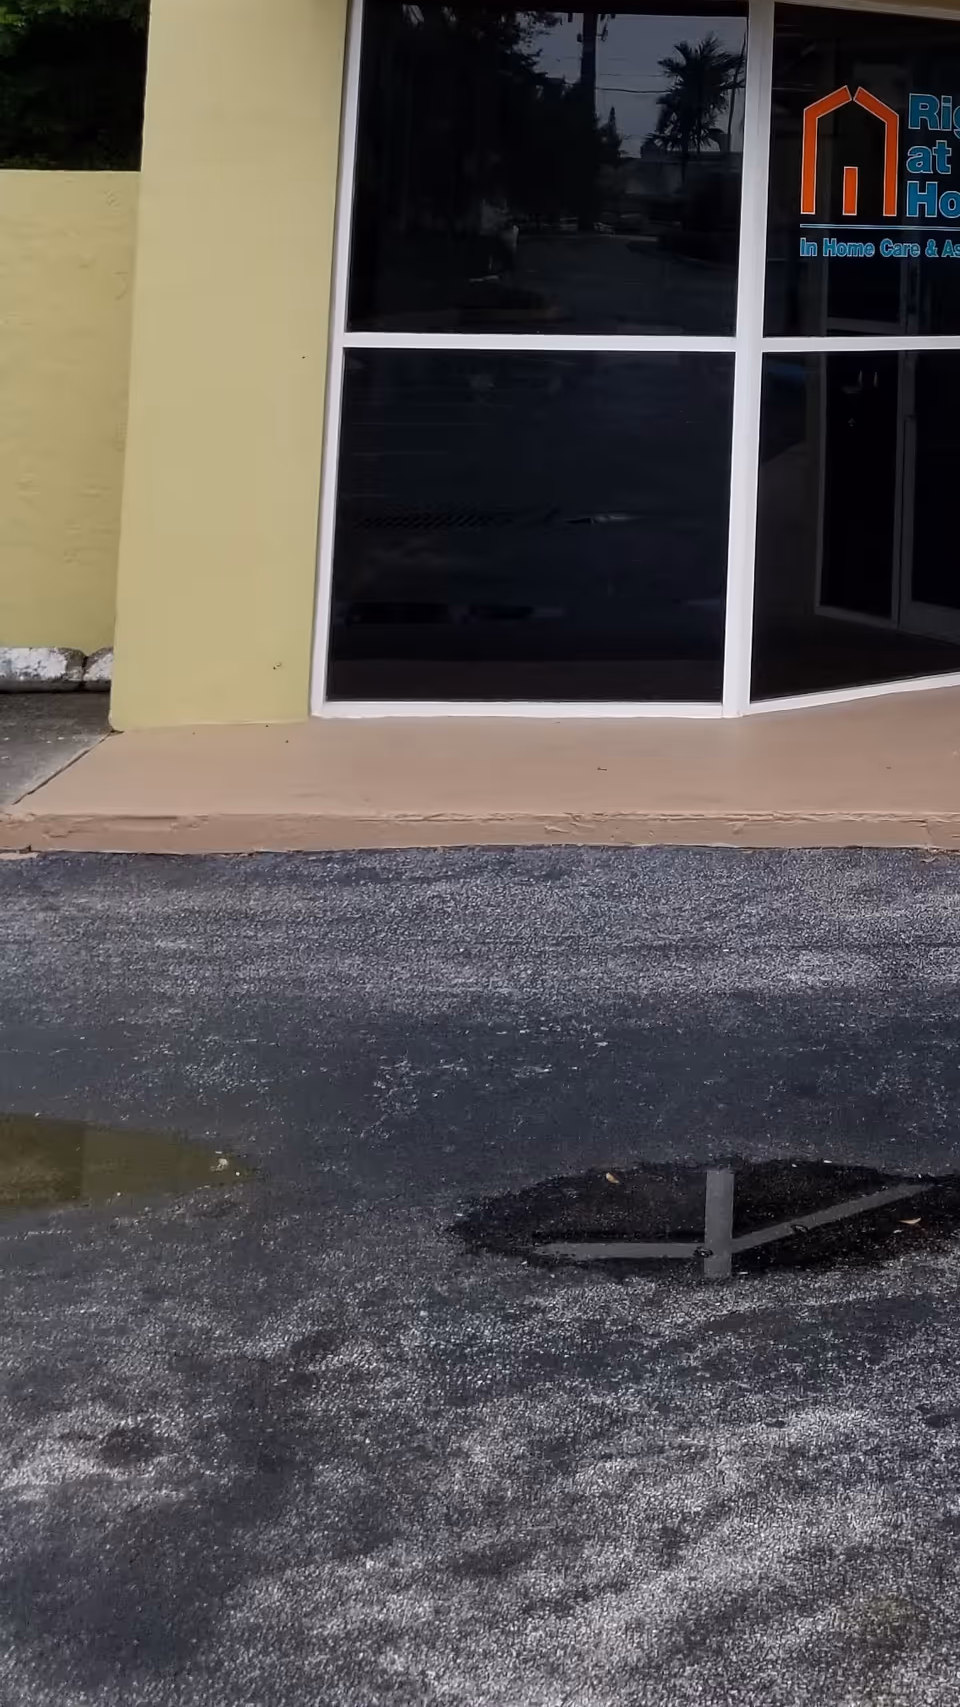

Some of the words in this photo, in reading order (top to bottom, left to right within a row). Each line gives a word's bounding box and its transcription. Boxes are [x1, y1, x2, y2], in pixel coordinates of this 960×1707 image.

[906, 140, 952, 174] at
[800, 238, 817, 256] In
[823, 238, 875, 257] Home
[880, 239, 920, 257] Care
[925, 239, 939, 258] &
